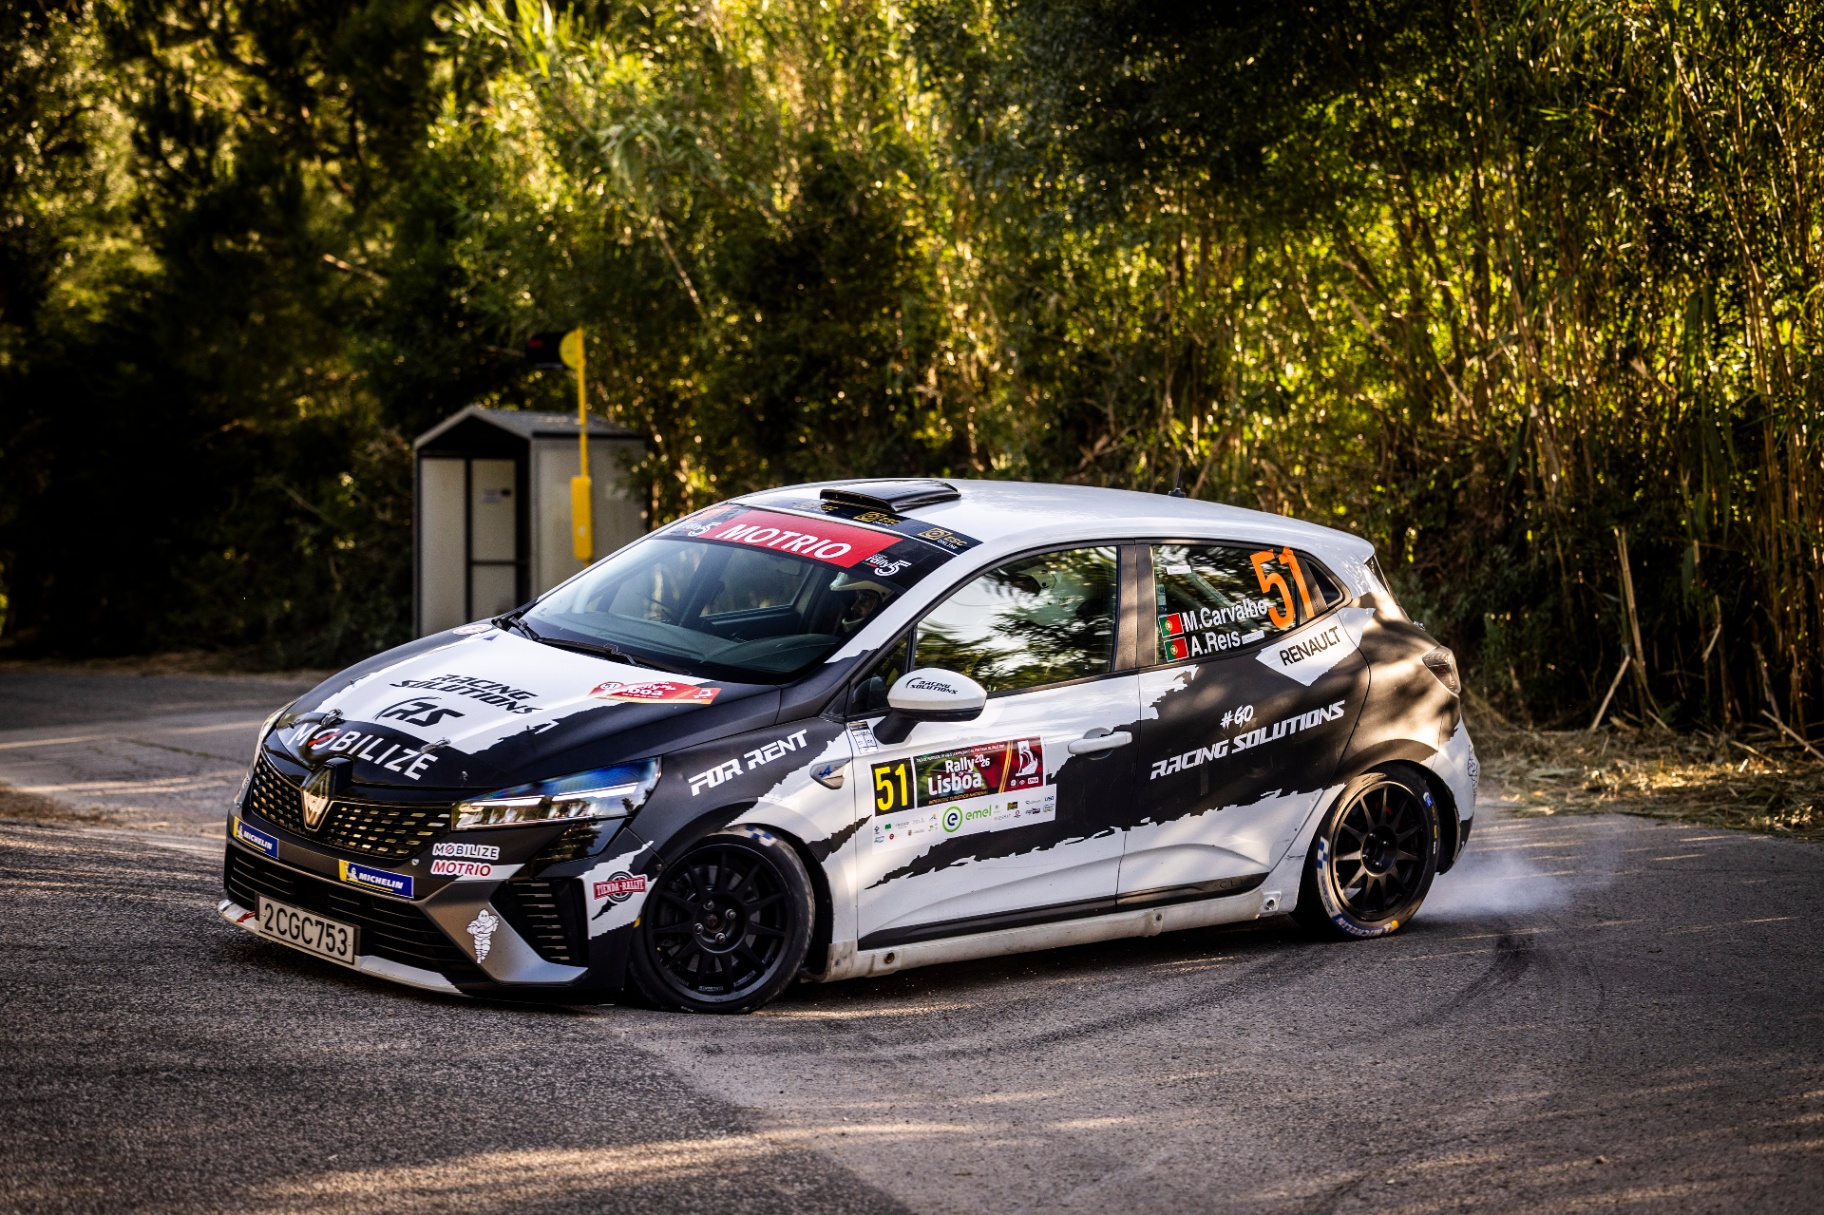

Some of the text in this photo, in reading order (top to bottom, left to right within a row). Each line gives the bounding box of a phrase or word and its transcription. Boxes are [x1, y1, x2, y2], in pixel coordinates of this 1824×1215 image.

[715, 523, 852, 559] MOTRIO
[1250, 546, 1315, 630] 51
[1182, 598, 1268, 632] M.Carvalho
[1191, 630, 1241, 657] A.Reis
[1279, 625, 1341, 666] RENAULT
[389, 679, 544, 714] SOLUTIONS
[430, 673, 539, 700] RACING
[910, 684, 958, 695] SOLUTIONS
[1150, 700, 1345, 780] RACING SOLUTIONS
[688, 758, 743, 797] FOR
[744, 729, 807, 771] RENT
[945, 757, 974, 773] Rally
[874, 763, 908, 811] 51
[928, 772, 982, 796] Lisboa
[965, 805, 992, 821] emel
[243, 830, 273, 850] MICHELIN
[358, 872, 404, 890] MICHELIN
[432, 861, 491, 877] MOTRIO
[264, 902, 349, 957] 2CGC753
